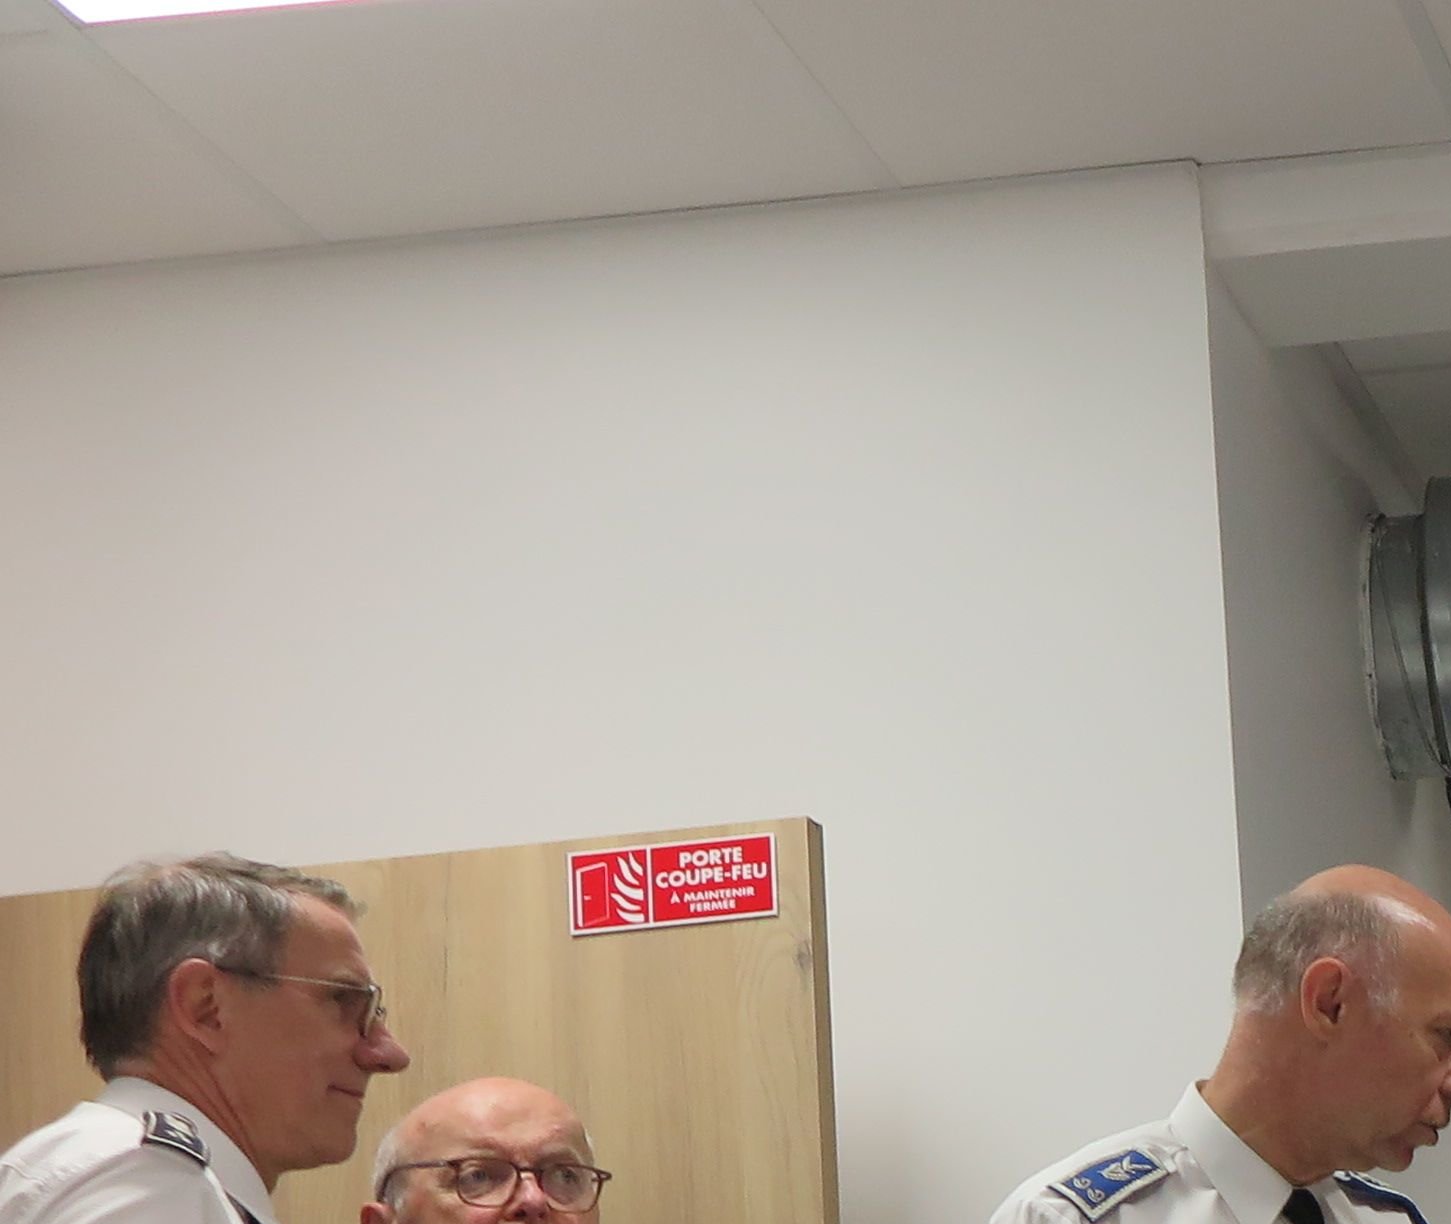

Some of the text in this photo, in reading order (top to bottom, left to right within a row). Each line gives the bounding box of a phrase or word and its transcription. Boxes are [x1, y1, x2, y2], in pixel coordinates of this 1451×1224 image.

[678, 846, 743, 868] PORTE
[655, 862, 767, 889] COUPE-FEU
[670, 886, 755, 905] À MAINTENIR
[690, 899, 736, 913] FERMÉE
